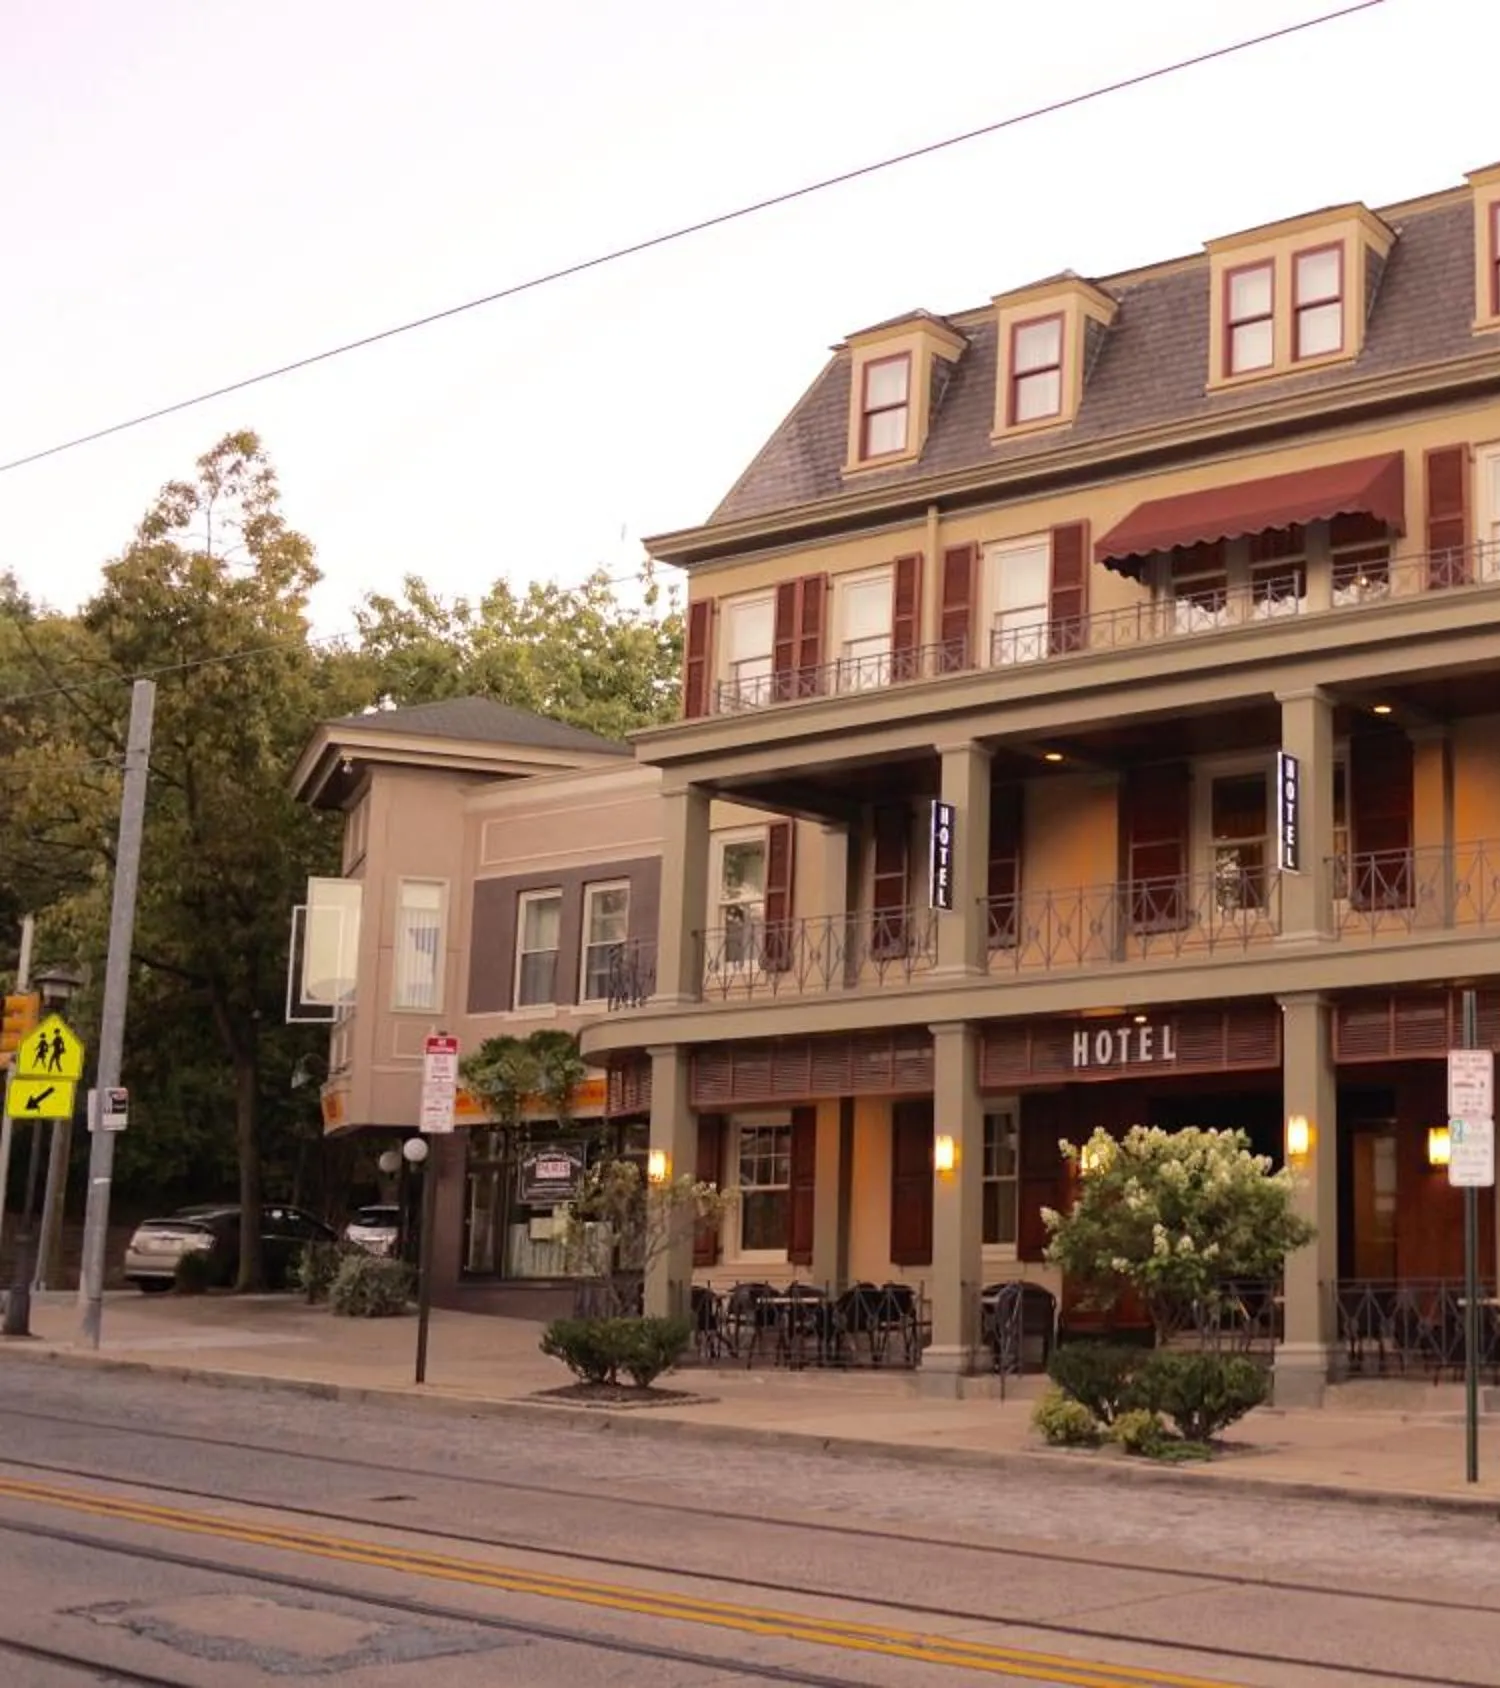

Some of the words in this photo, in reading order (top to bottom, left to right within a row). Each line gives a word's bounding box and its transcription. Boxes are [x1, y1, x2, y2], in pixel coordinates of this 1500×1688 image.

[939, 806, 950, 908] HOTEL
[1285, 758, 1296, 868] HOTEL
[1073, 1024, 1177, 1067] HOTEL
